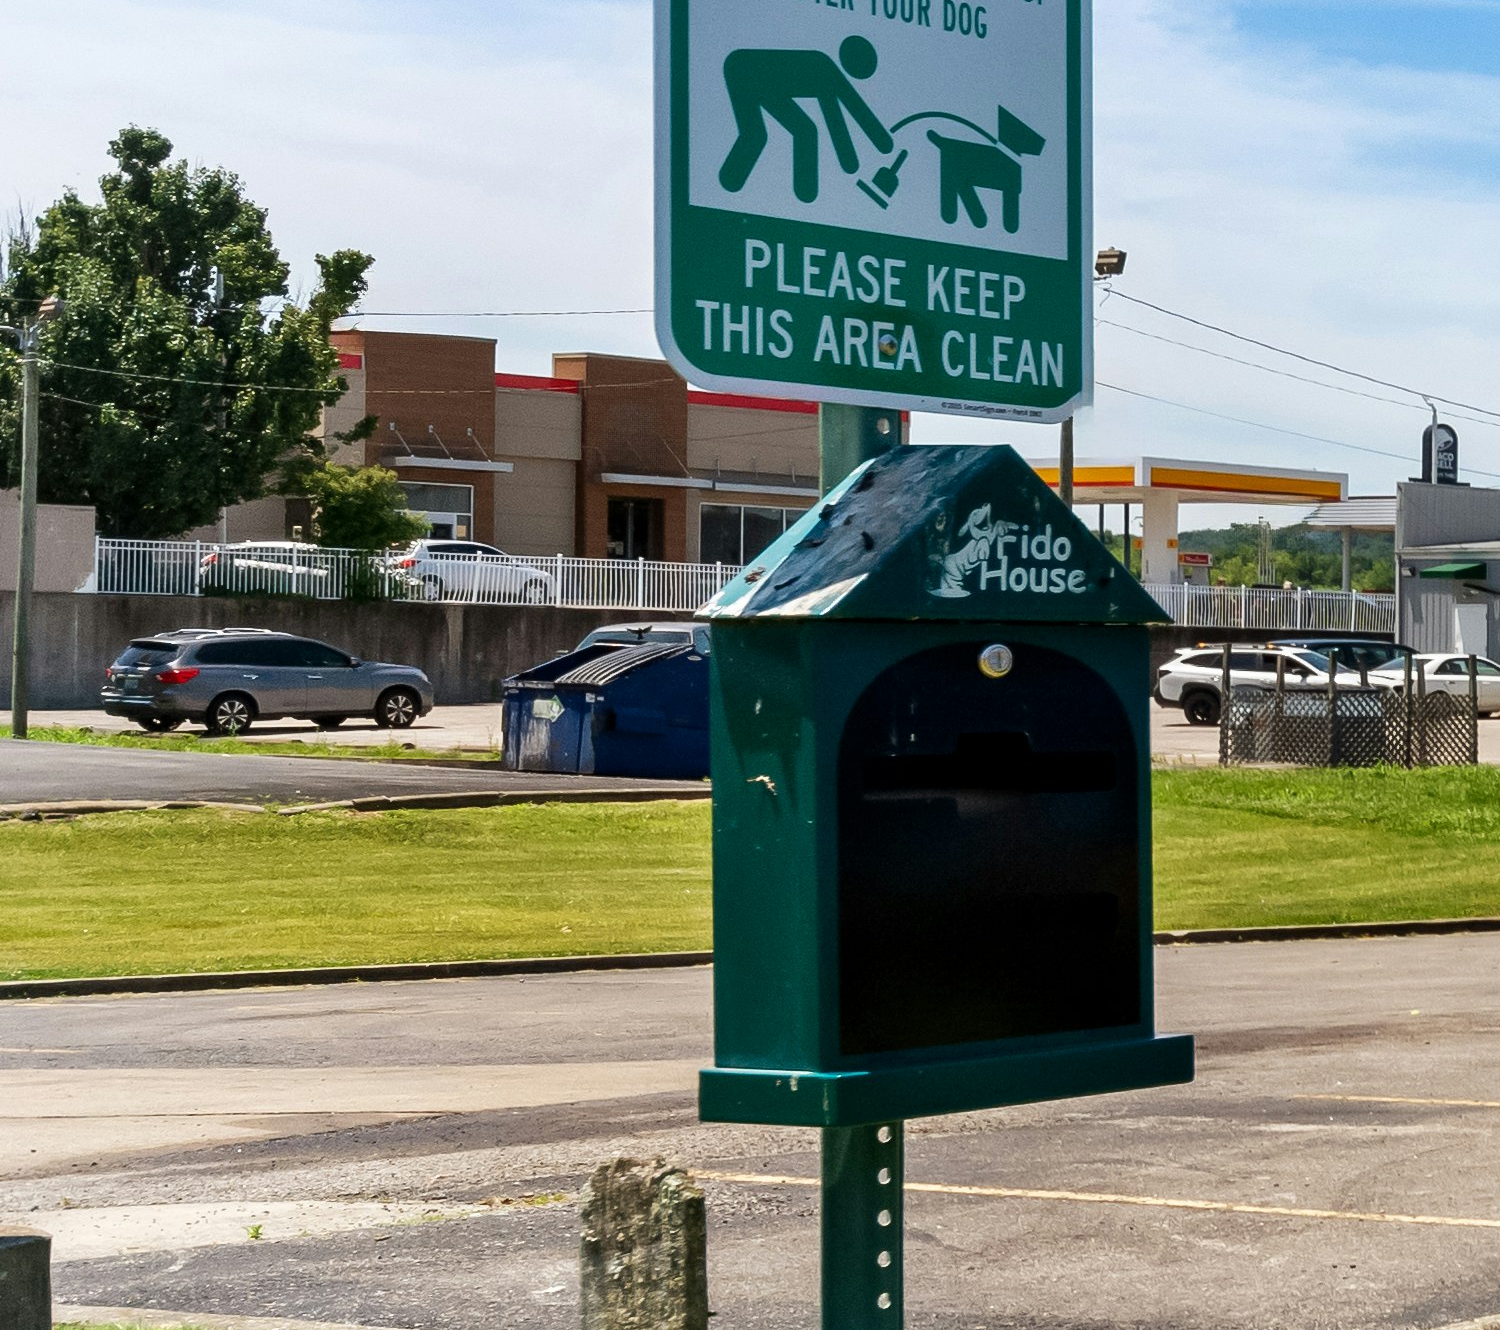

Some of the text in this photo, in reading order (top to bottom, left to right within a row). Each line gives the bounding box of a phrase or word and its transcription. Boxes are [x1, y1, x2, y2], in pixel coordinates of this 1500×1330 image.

[744, 238, 1026, 320] PLEASE KEEP
[695, 299, 1064, 388] THIS AREA CLEAN
[1435, 451, 1454, 461] ACO
[996, 521, 1072, 562] Fido
[980, 555, 1087, 594] House
